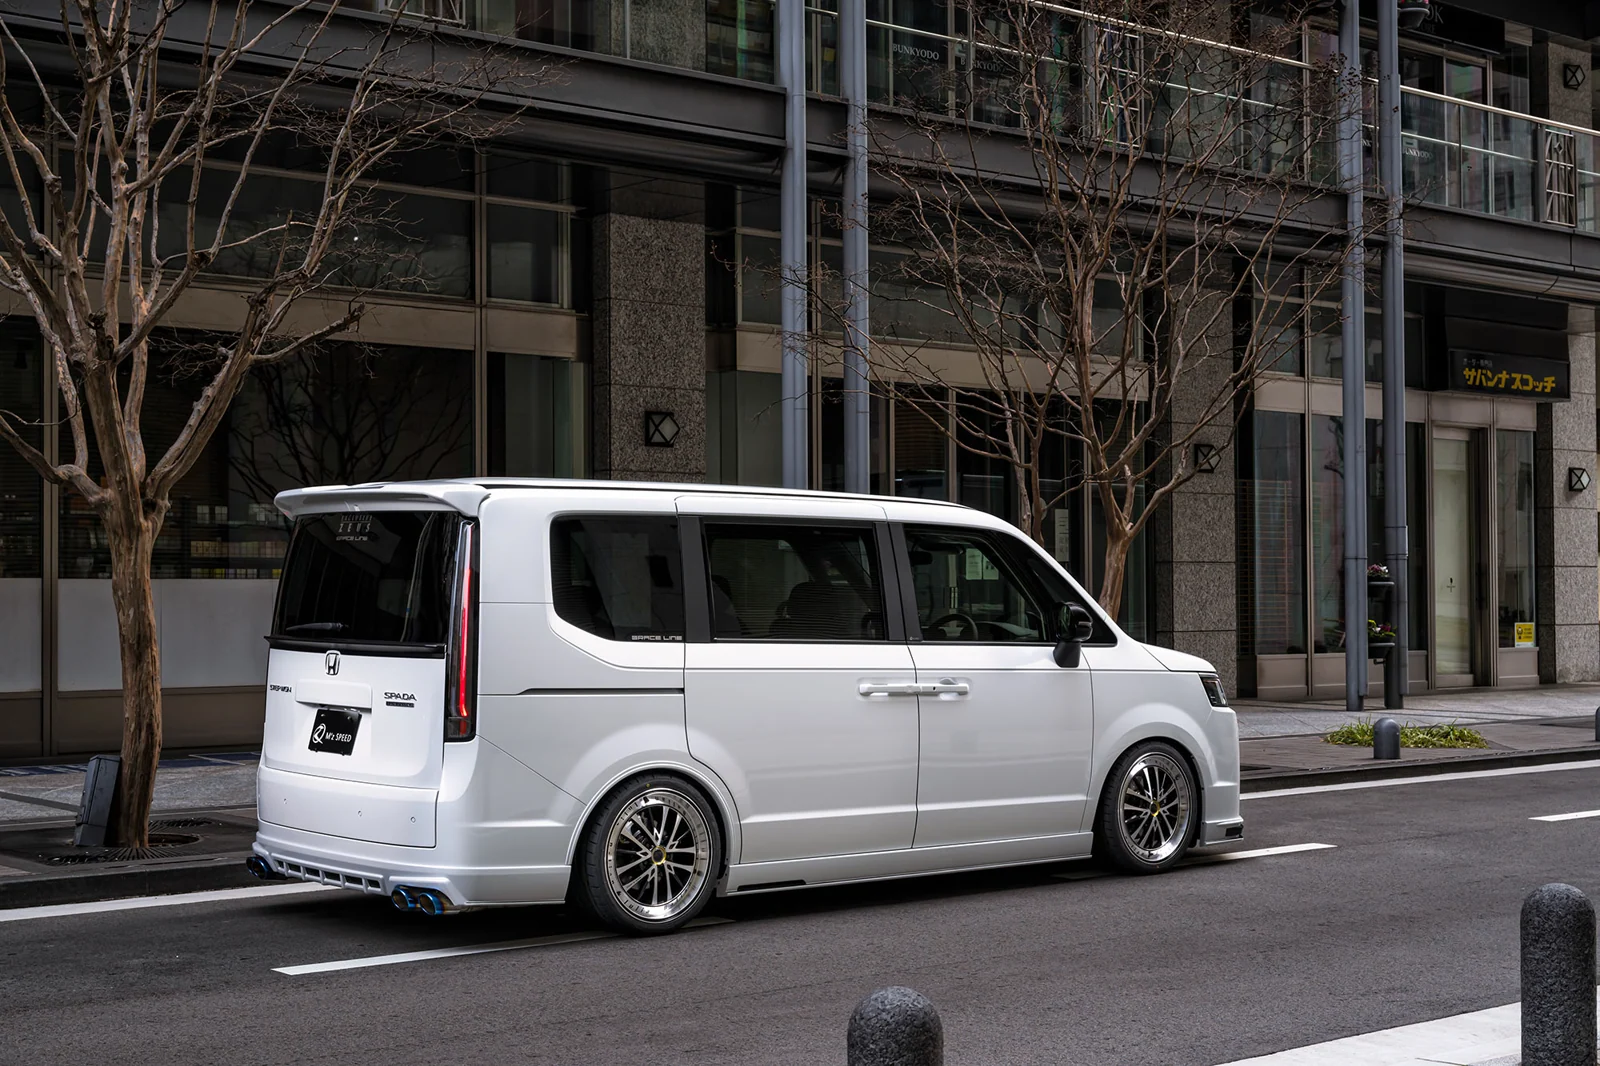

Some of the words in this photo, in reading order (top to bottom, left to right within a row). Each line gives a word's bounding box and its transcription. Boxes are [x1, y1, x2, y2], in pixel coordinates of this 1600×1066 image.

[892, 43, 940, 60] BUNKYODO
[384, 691, 418, 701] SPADA
[335, 733, 352, 742] SPEED
